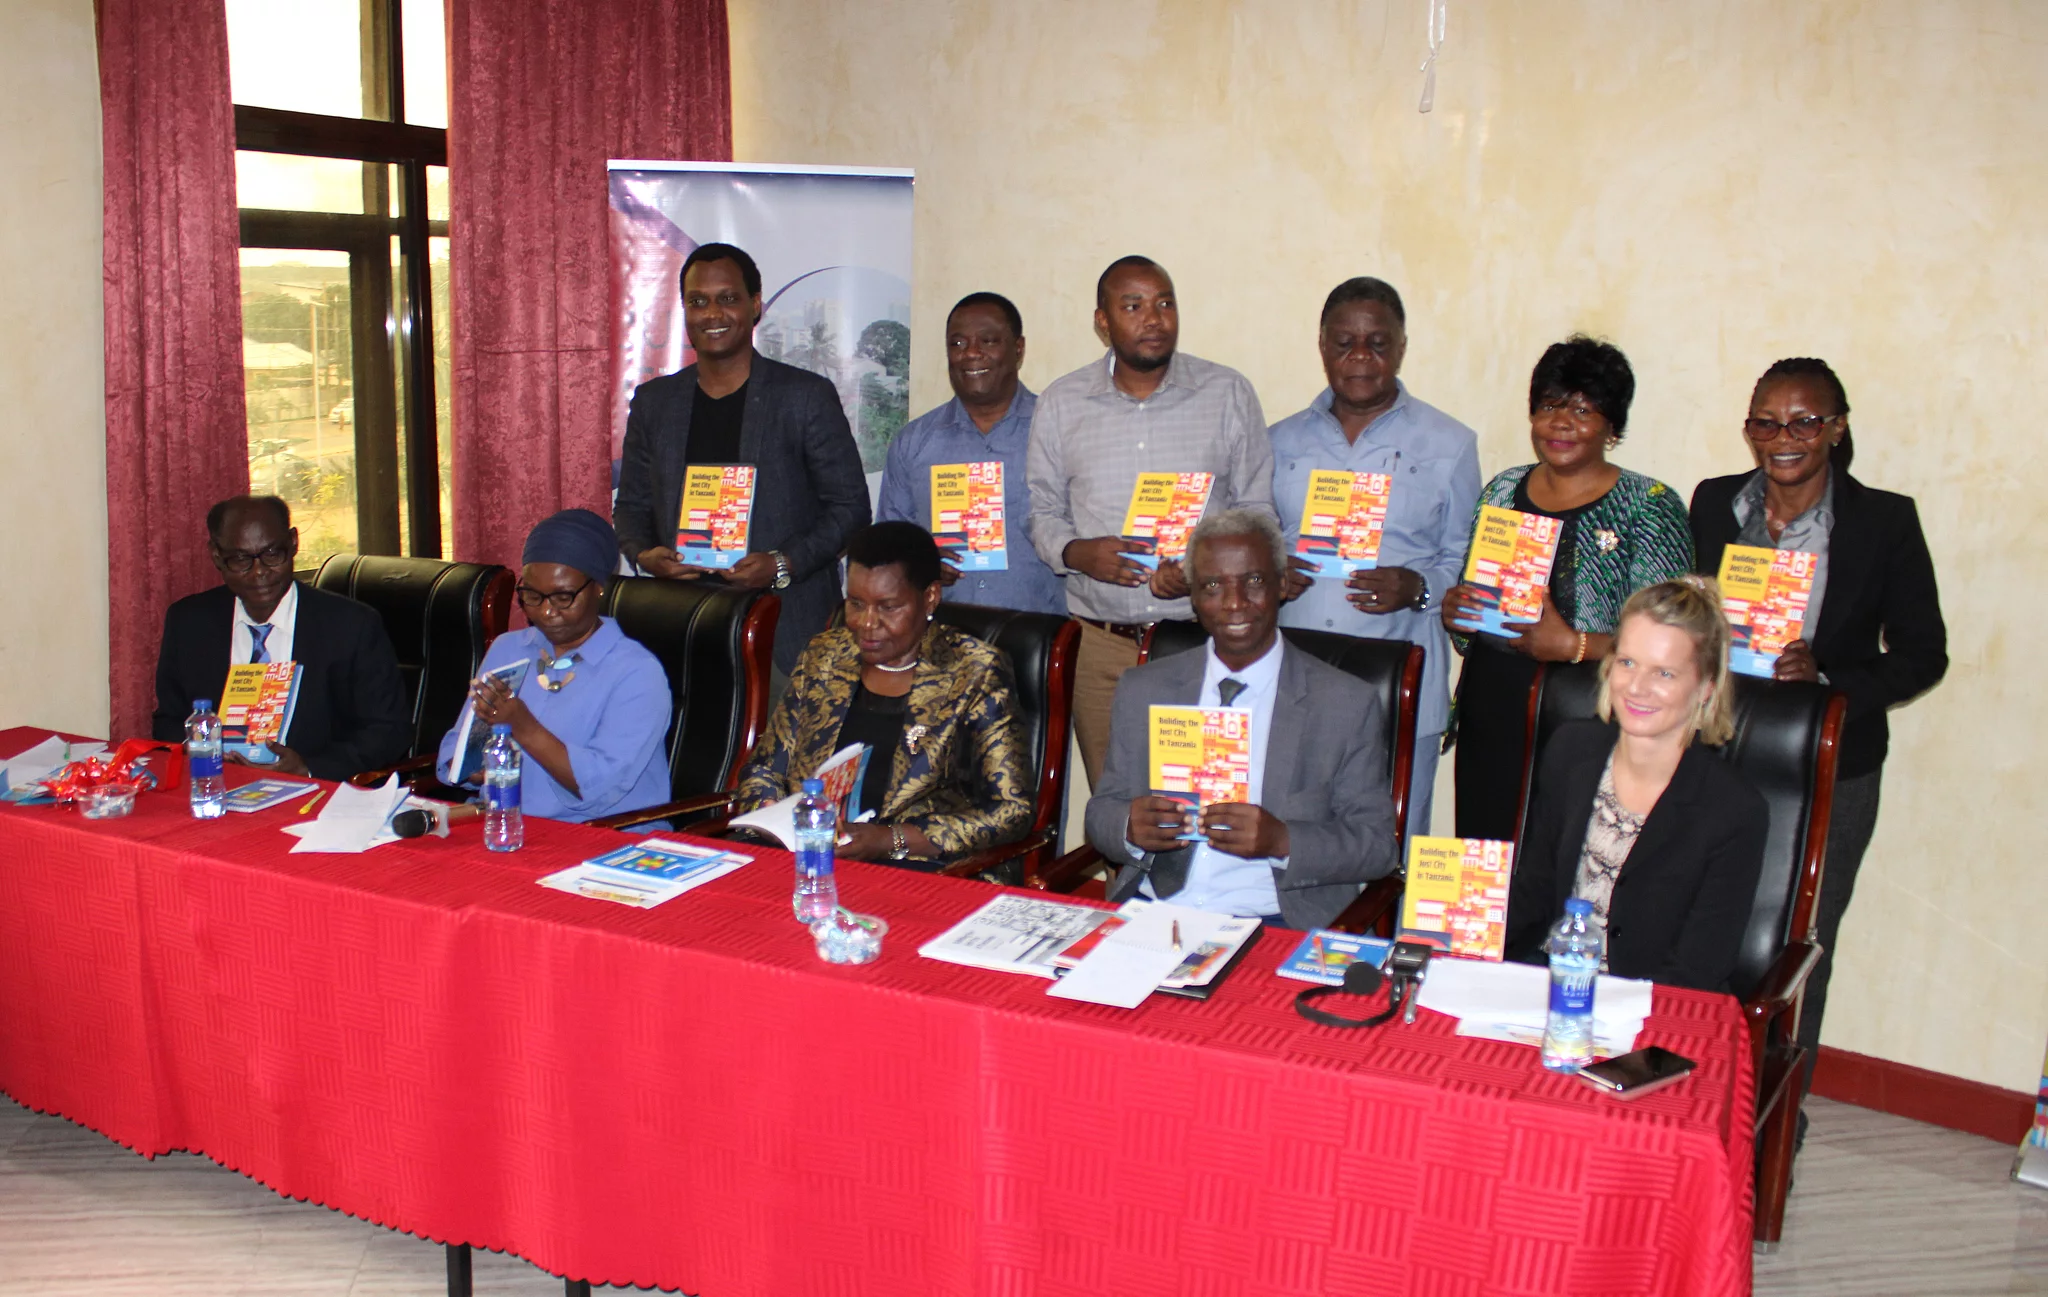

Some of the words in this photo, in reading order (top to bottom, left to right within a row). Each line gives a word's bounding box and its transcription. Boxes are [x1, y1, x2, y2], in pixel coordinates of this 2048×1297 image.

[1159, 716, 1186, 727] Building
[1174, 729, 1186, 738] City
[1167, 740, 1197, 748] Tanzania
[1420, 848, 1447, 859] Building
[1449, 850, 1459, 858] the
[1434, 860, 1446, 870] City
[1425, 872, 1455, 882] Tanzania
